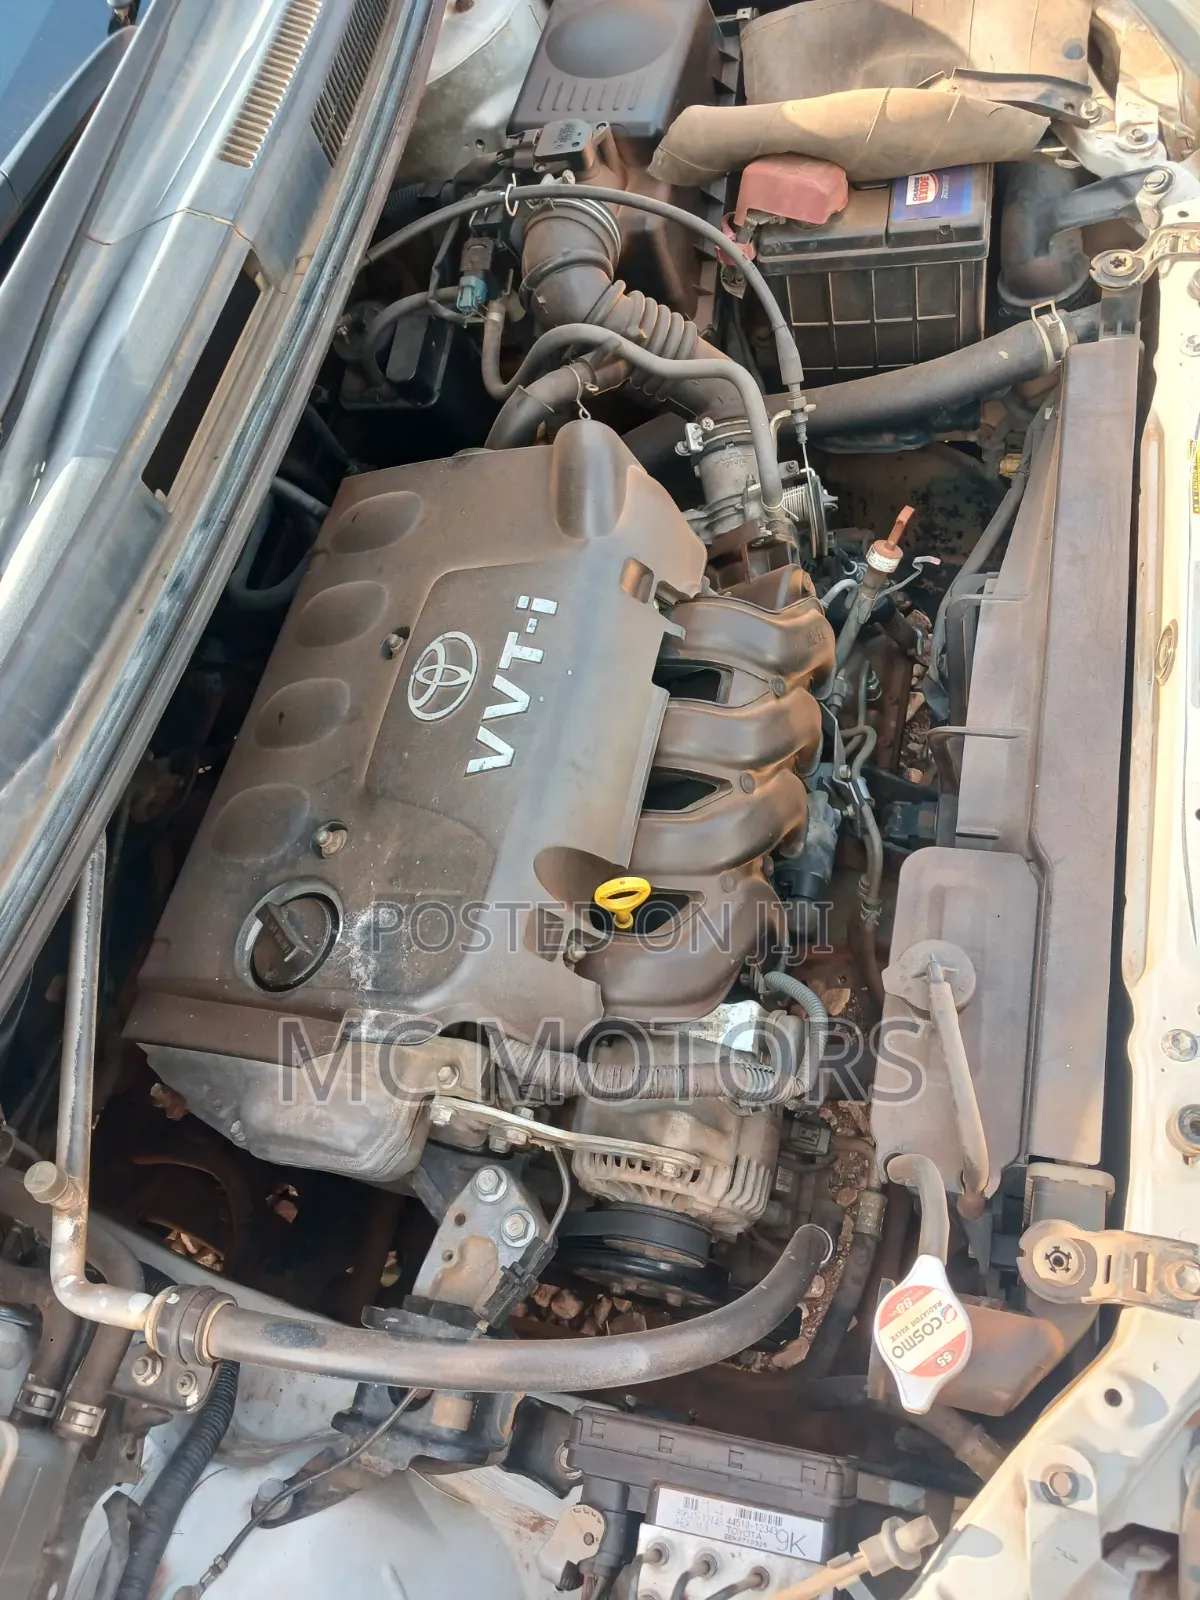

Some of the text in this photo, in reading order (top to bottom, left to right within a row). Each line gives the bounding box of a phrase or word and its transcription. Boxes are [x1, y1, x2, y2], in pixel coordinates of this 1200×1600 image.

[918, 175, 930, 202] EXIDE
[464, 595, 558, 775] VVT-i
[889, 1300, 942, 1343] RADIATOR VALVE
[892, 1316, 943, 1359] COSMO
[726, 1526, 763, 1541] TOYOTA
[776, 1529, 808, 1556] 9K
